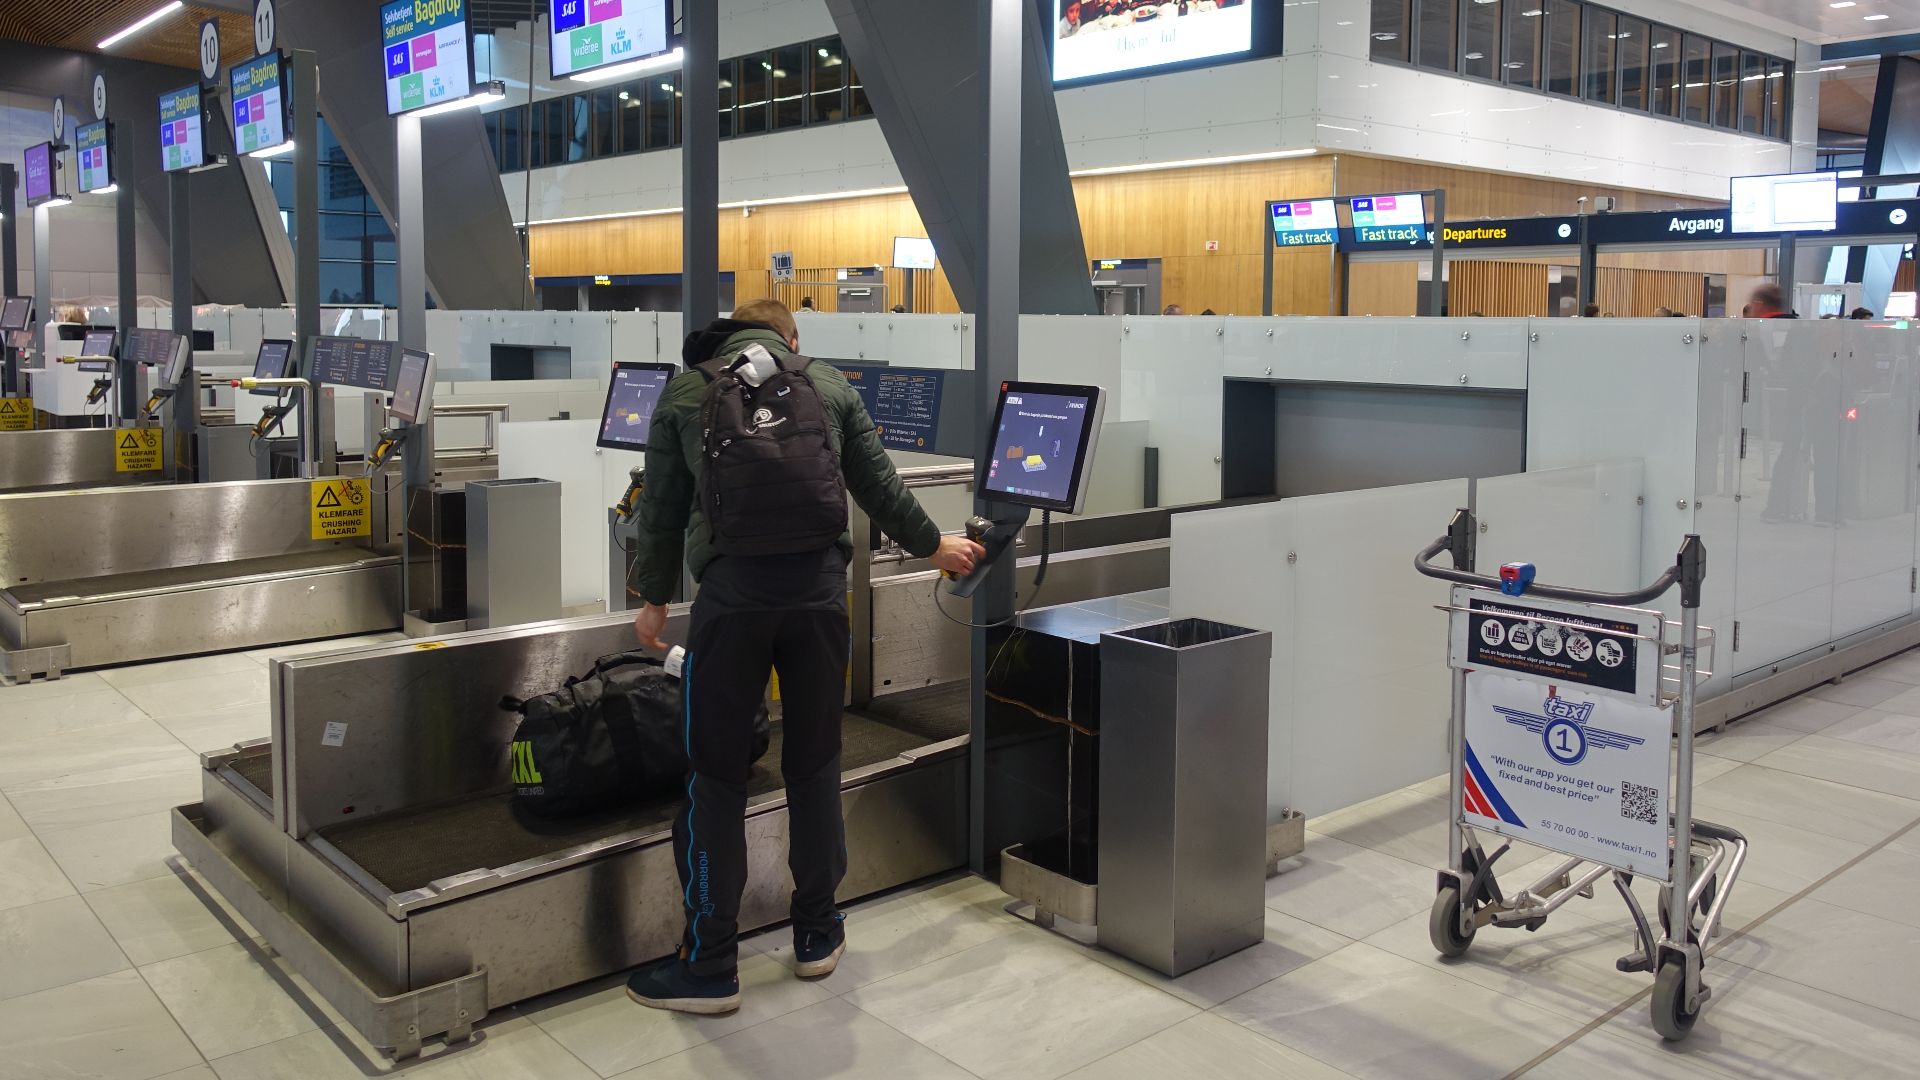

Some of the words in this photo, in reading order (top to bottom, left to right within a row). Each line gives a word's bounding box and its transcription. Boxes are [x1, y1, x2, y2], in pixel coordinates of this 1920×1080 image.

[384, 6, 412, 24] Selvbetjent
[414, 0, 460, 25] Bagdrop
[562, 0, 576, 17] SAS
[258, 11, 270, 42] 11
[386, 25, 396, 39] Self
[397, 21, 414, 36] service
[204, 37, 216, 65] 10
[610, 40, 632, 55] KLM
[392, 52, 404, 66] SAS
[250, 60, 278, 86] Bagdrop
[97, 87, 102, 108] 9
[430, 86, 445, 98] KLM
[176, 92, 198, 114] Bagdrop
[56, 109, 60, 128] 8
[1362, 228, 1385, 241] Fast
[1386, 226, 1418, 240] track
[1669, 217, 1724, 233] Avgang
[1282, 232, 1304, 245] Fast
[1306, 230, 1332, 244] track
[1444, 228, 1506, 242] Departures
[318, 509, 364, 518] KLEMFARE
[321, 519, 361, 529] CRUSHING
[326, 528, 357, 536] HAZARD
[1545, 696, 1594, 724] taxi
[1556, 728, 1572, 752] 1
[1498, 770, 1522, 783] fixed
[1524, 778, 1542, 788] and
[1544, 782, 1566, 795] best
[1517, 762, 1534, 773] our
[1536, 767, 1554, 780] app
[1556, 774, 1575, 786] you
[1577, 778, 1594, 790] get
[1596, 784, 1615, 795] our
[1540, 820, 1551, 829] 55
[1553, 823, 1564, 832] 70
[1565, 826, 1576, 836] 00
[1578, 829, 1589, 839] 00
[1597, 836, 1657, 858] www.taxi1.no
